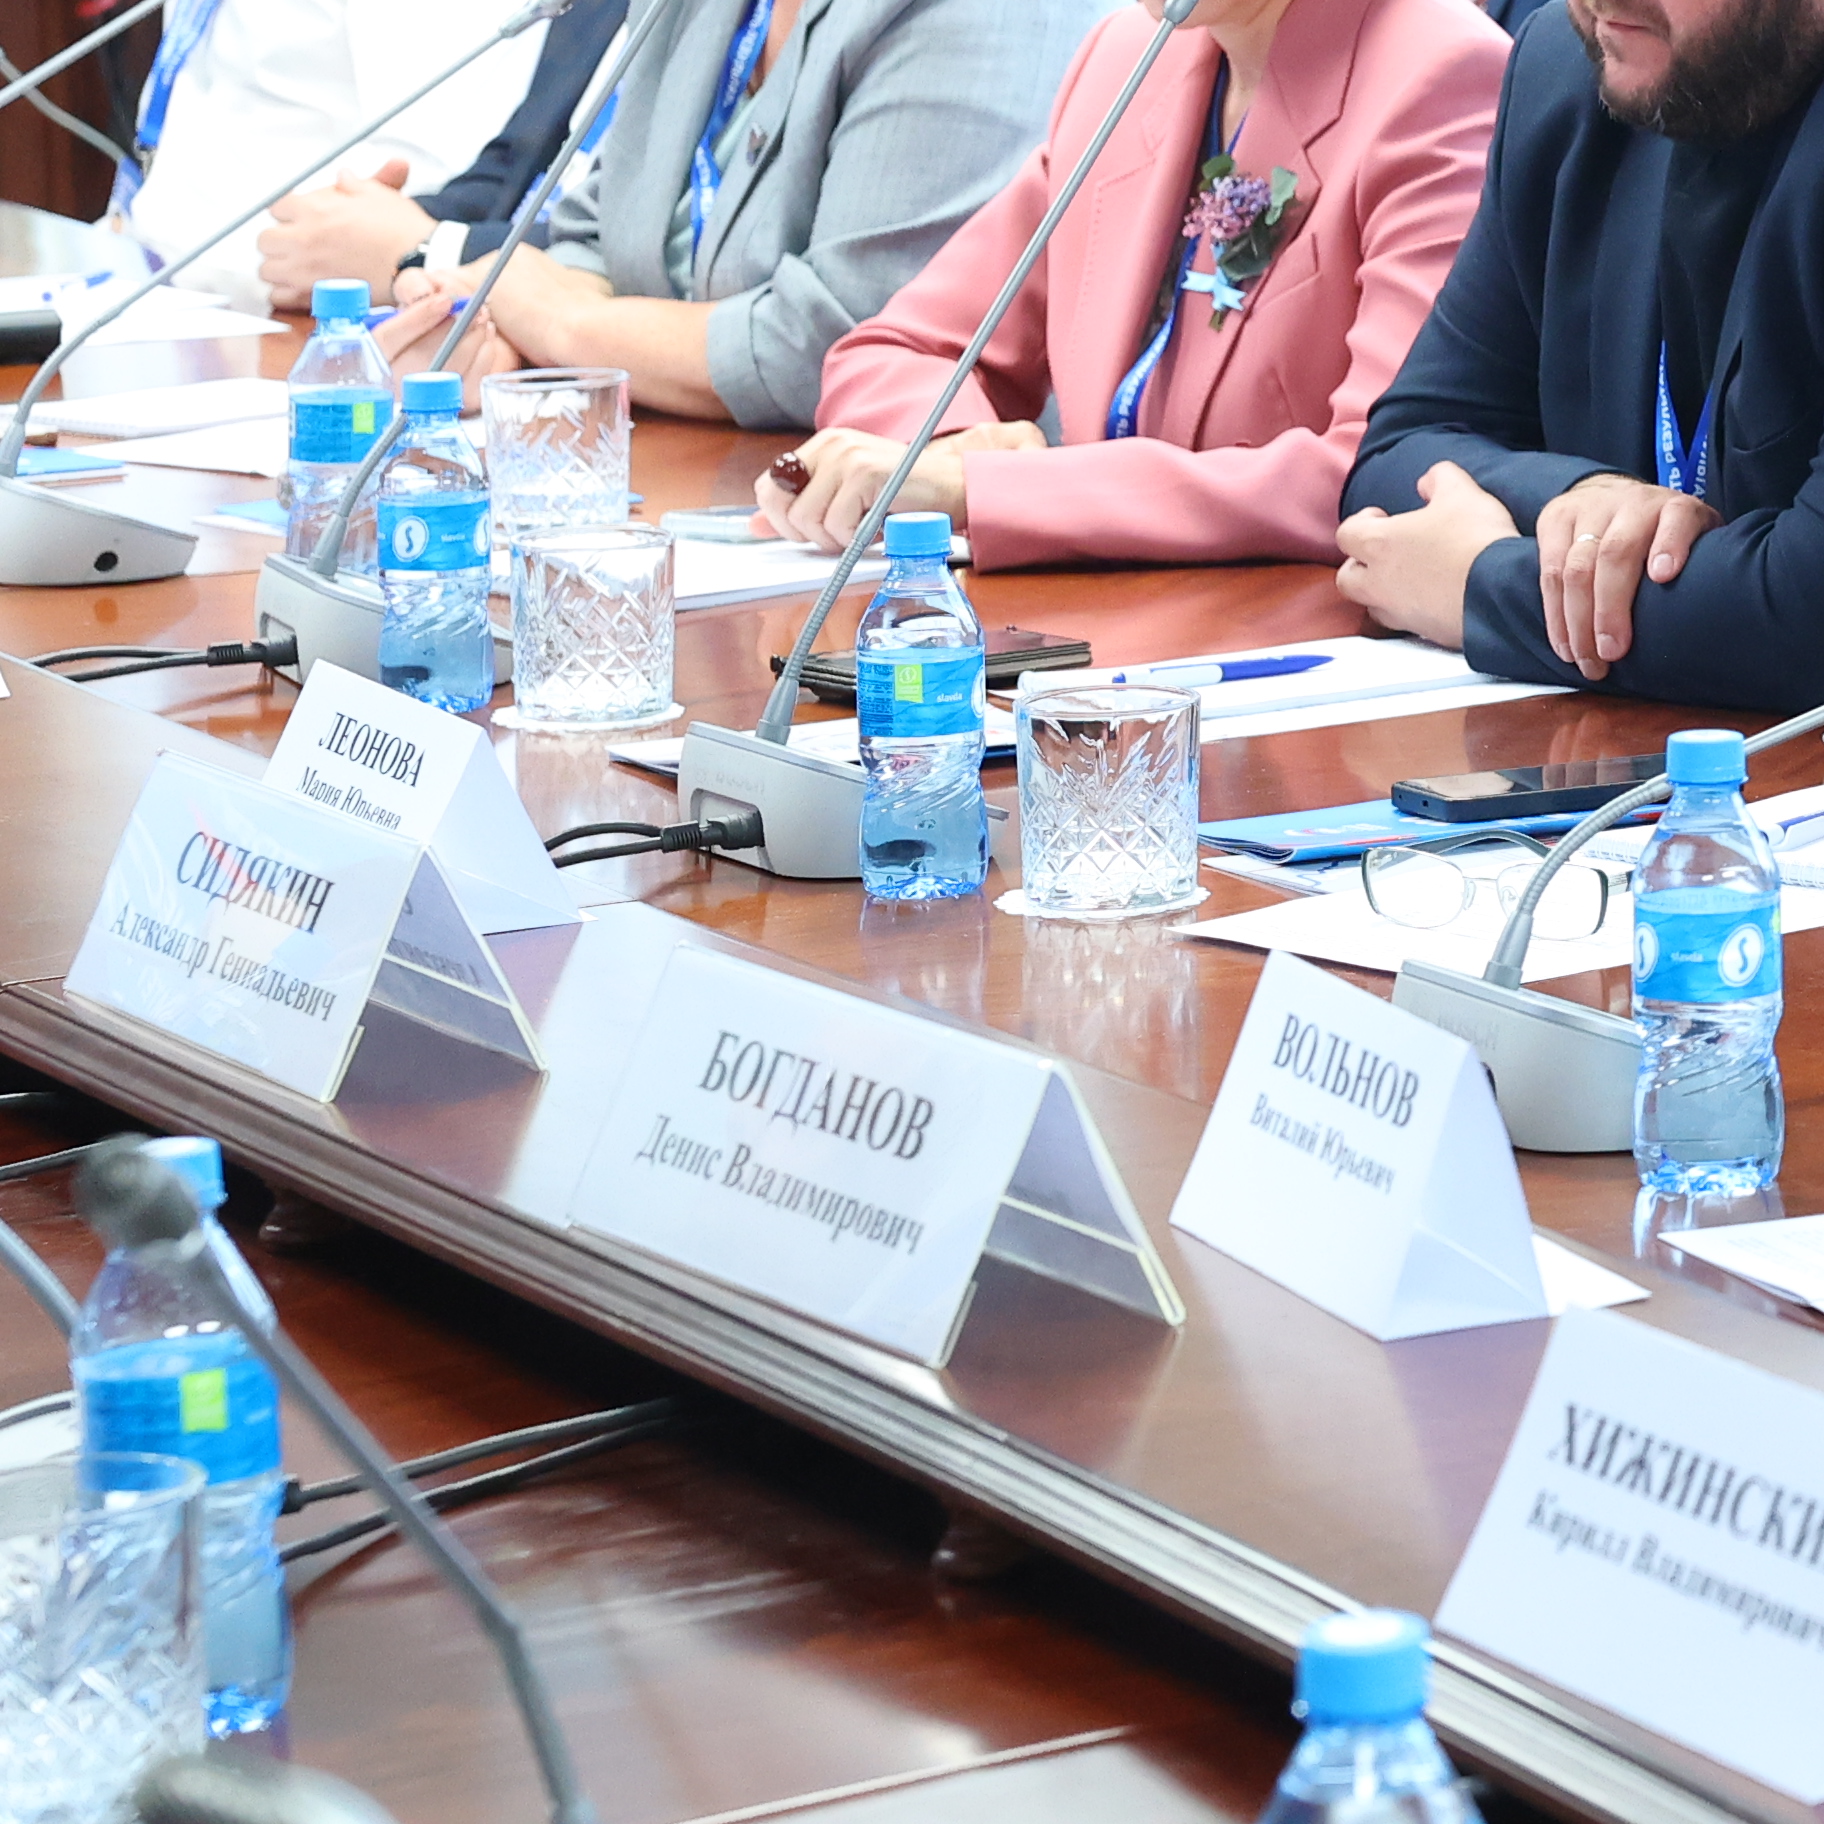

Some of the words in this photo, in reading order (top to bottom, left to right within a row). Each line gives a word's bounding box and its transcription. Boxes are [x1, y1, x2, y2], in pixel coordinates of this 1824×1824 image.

[296, 765, 343, 807] Мария
[339, 784, 402, 831] Юрьевна
[318, 711, 425, 788] ЛЕОНОВА
[176, 831, 336, 935] СИДЯКИН
[109, 899, 209, 978] Александр
[206, 935, 338, 1022] Геннадьевич
[696, 1029, 935, 1161] БОГДАНОВ
[1273, 1012, 1420, 1128] ВОЛЬНОВ
[633, 1114, 723, 1181] Денис
[720, 1142, 925, 1255] Владимирович
[1250, 1092, 1322, 1156] Виталий
[1319, 1126, 1397, 1195] Юрьевич
[1527, 1488, 1631, 1566] Кирилл
